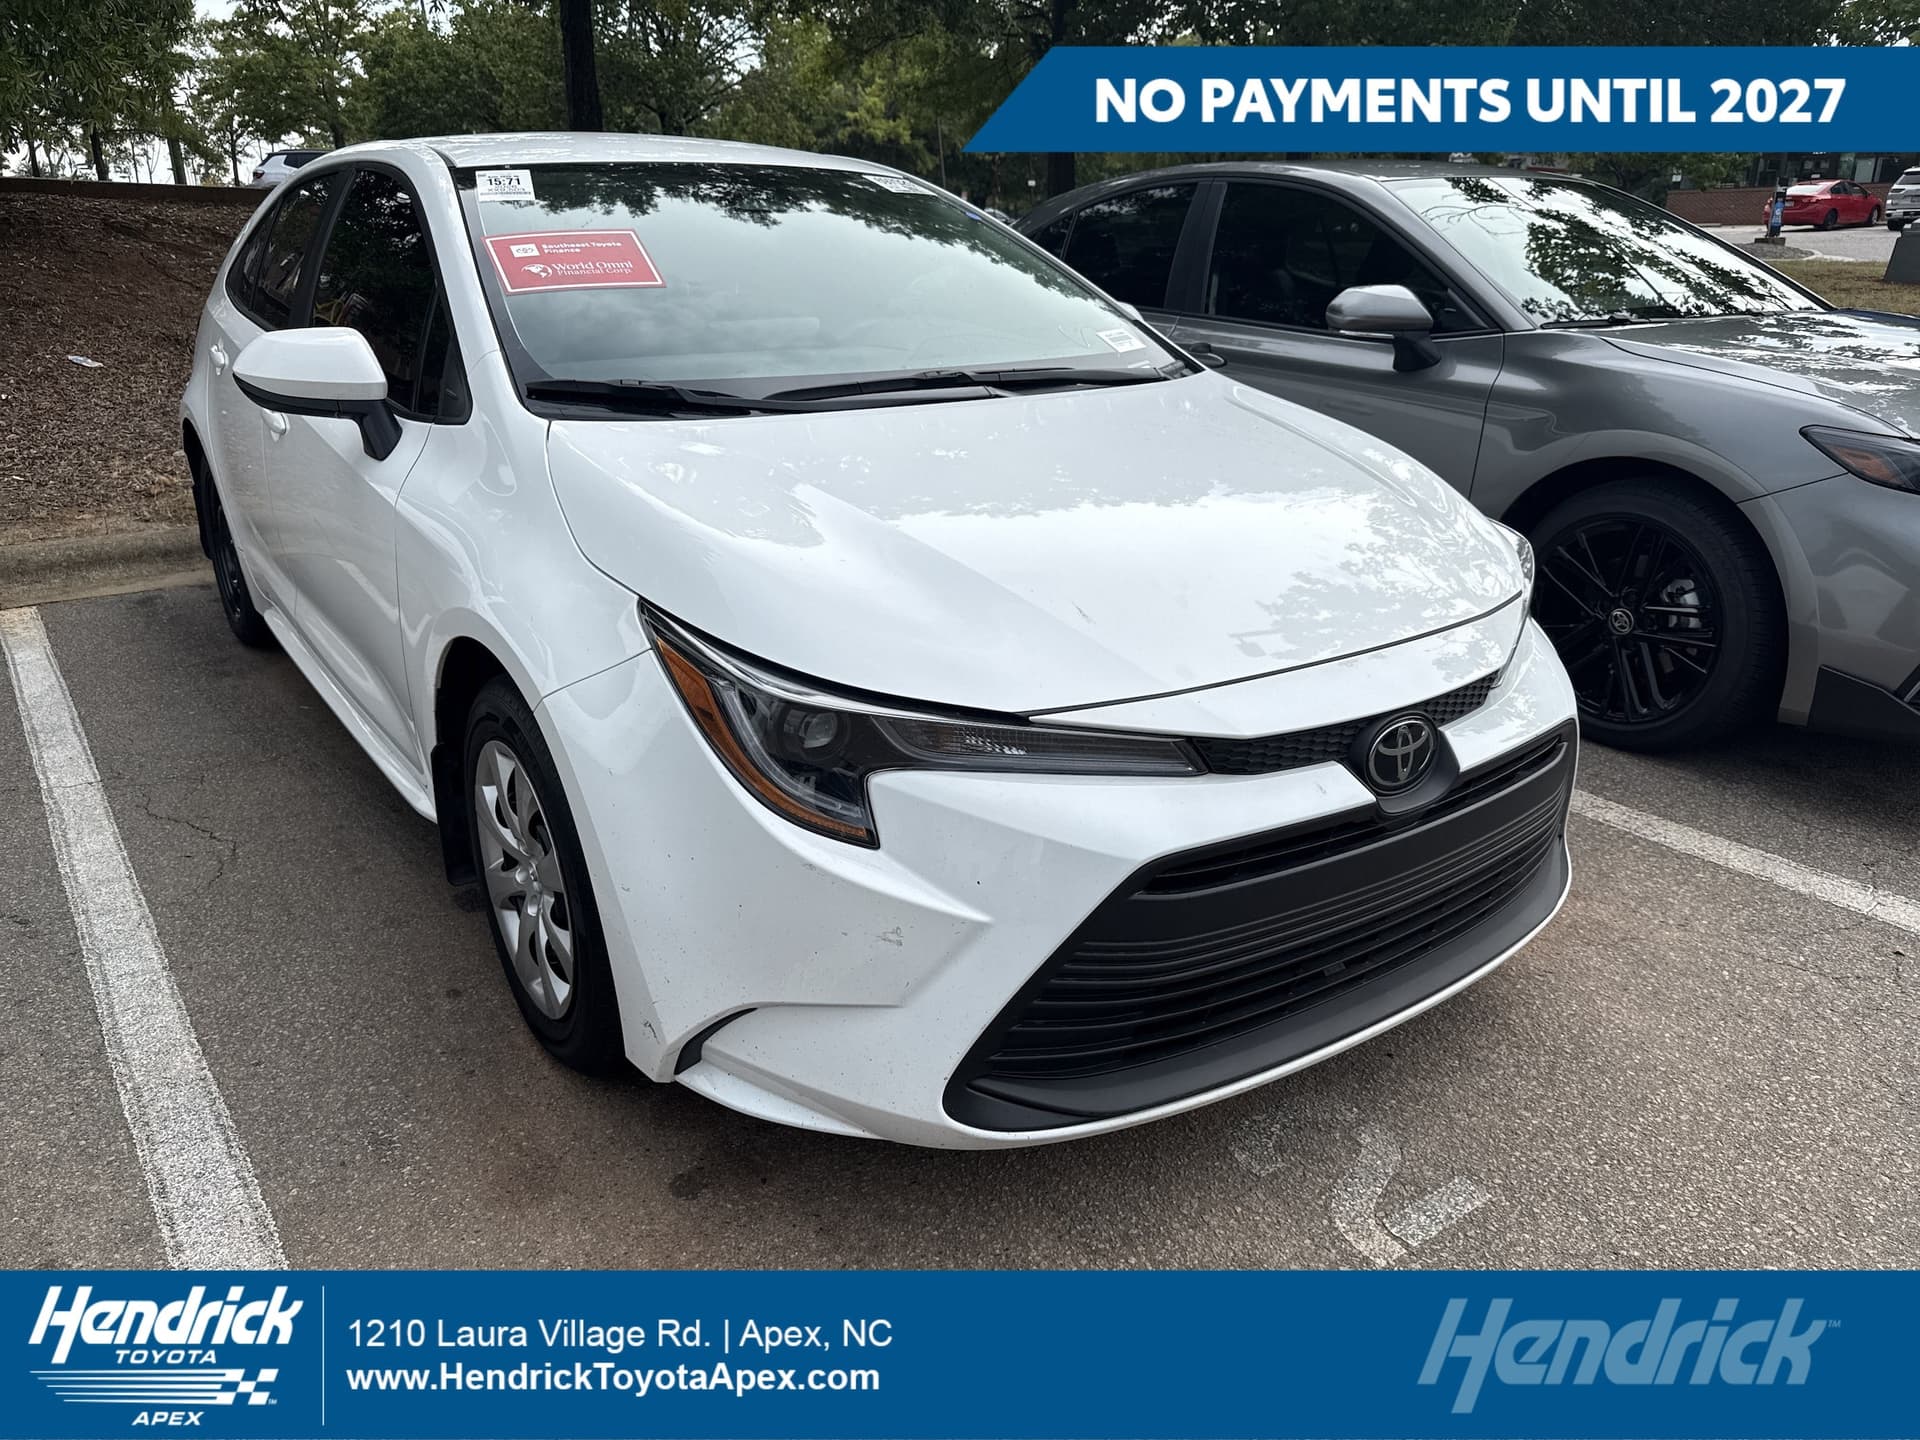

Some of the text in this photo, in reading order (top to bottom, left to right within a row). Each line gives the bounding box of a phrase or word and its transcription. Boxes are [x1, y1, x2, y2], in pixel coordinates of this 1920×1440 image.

[487, 177, 521, 186] 15:71
[551, 260, 633, 271] World Omni
[557, 267, 604, 275] Financial
